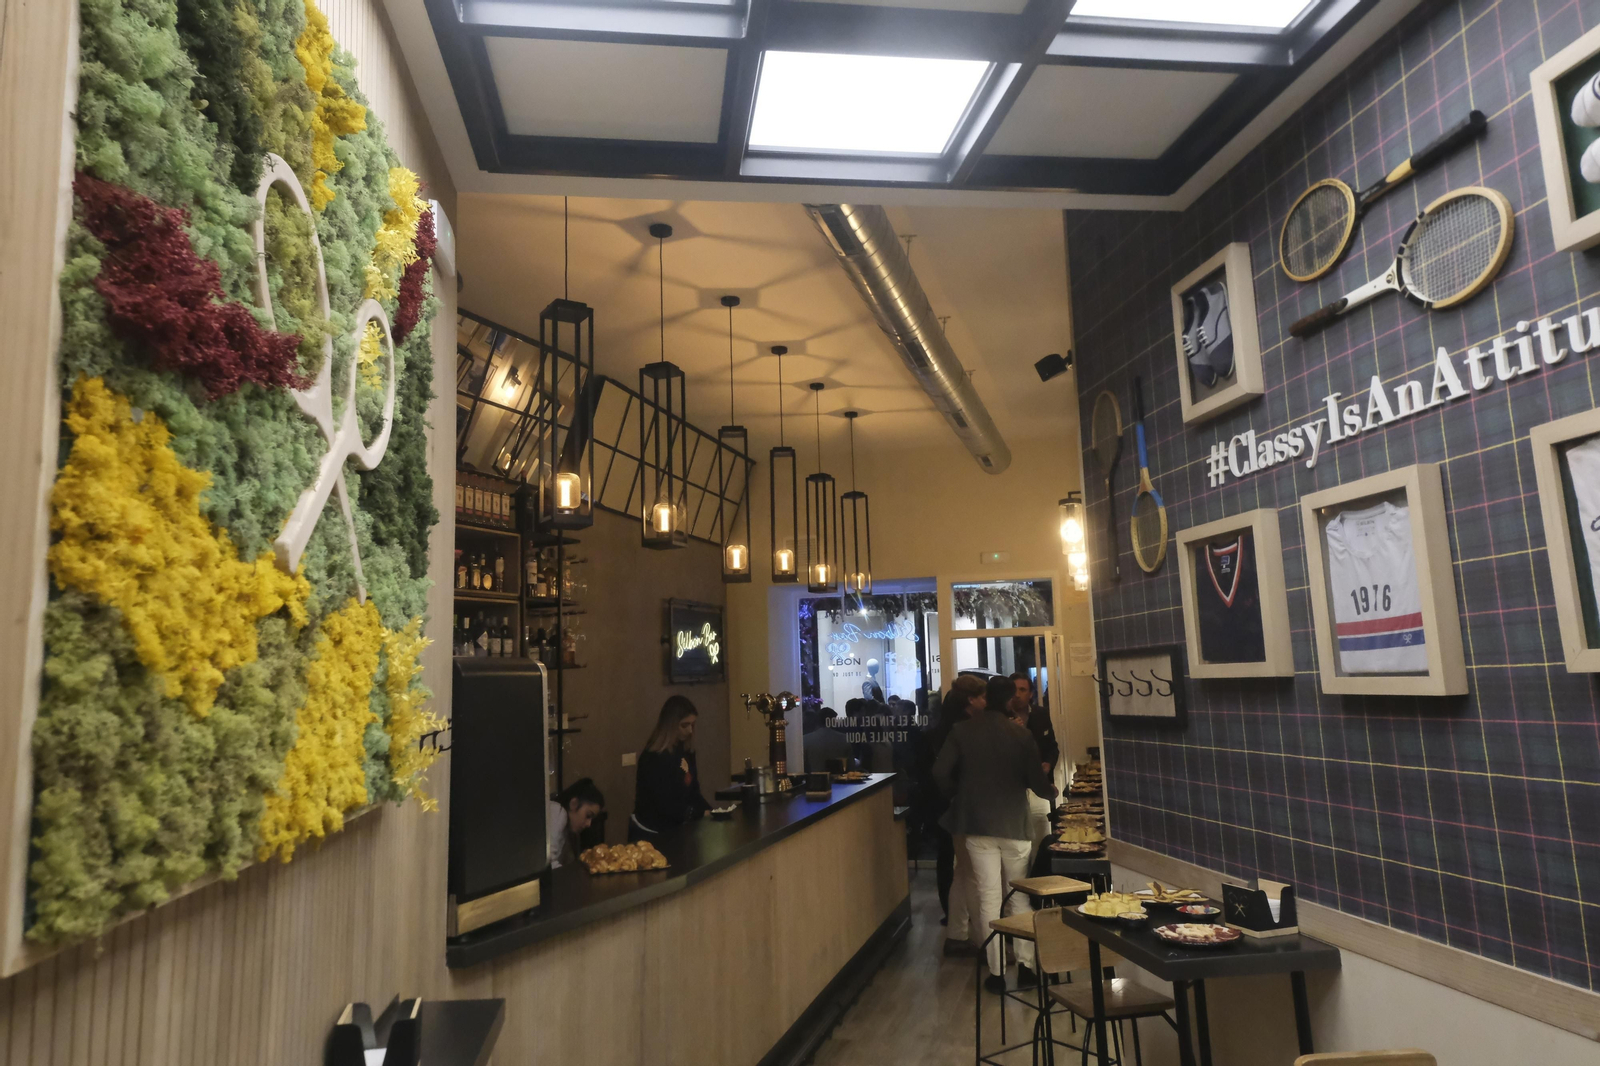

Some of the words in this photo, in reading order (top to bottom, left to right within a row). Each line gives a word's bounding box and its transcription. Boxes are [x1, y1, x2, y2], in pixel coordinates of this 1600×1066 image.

[1351, 584, 1392, 617] 1976
[677, 630, 703, 658] Silbon
[701, 622, 717, 647] Bar
[832, 657, 861, 666] BON
